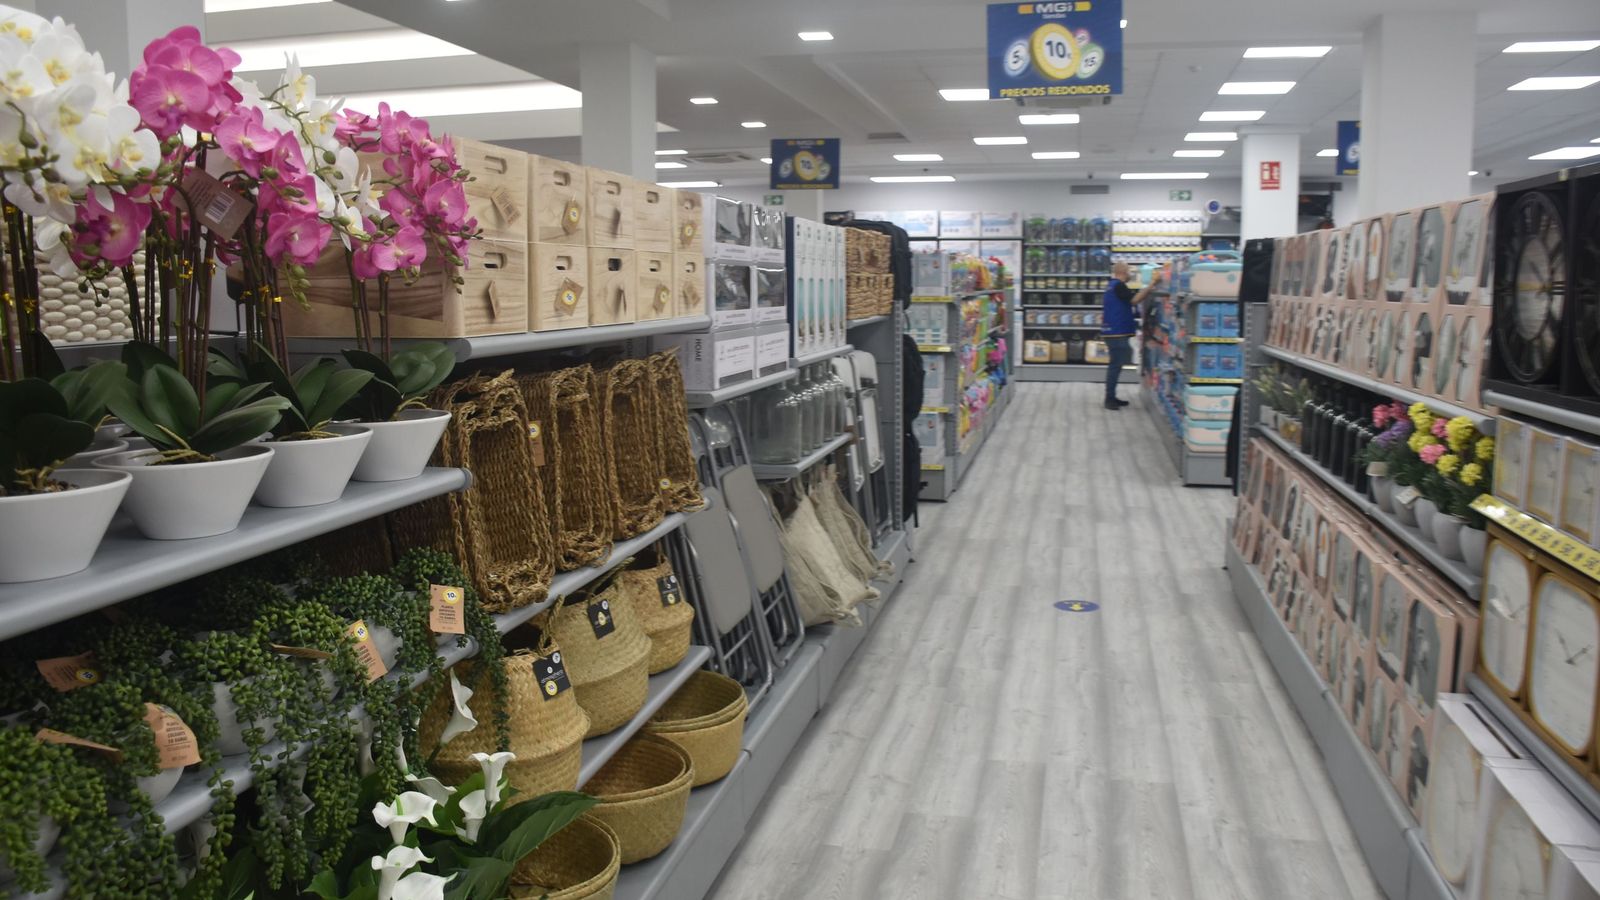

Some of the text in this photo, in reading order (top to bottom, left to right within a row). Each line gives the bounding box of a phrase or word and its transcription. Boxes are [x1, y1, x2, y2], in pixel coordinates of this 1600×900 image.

[1036, 3, 1073, 13] MGi
[1001, 85, 1111, 97] PRECIOS REDONDOS
